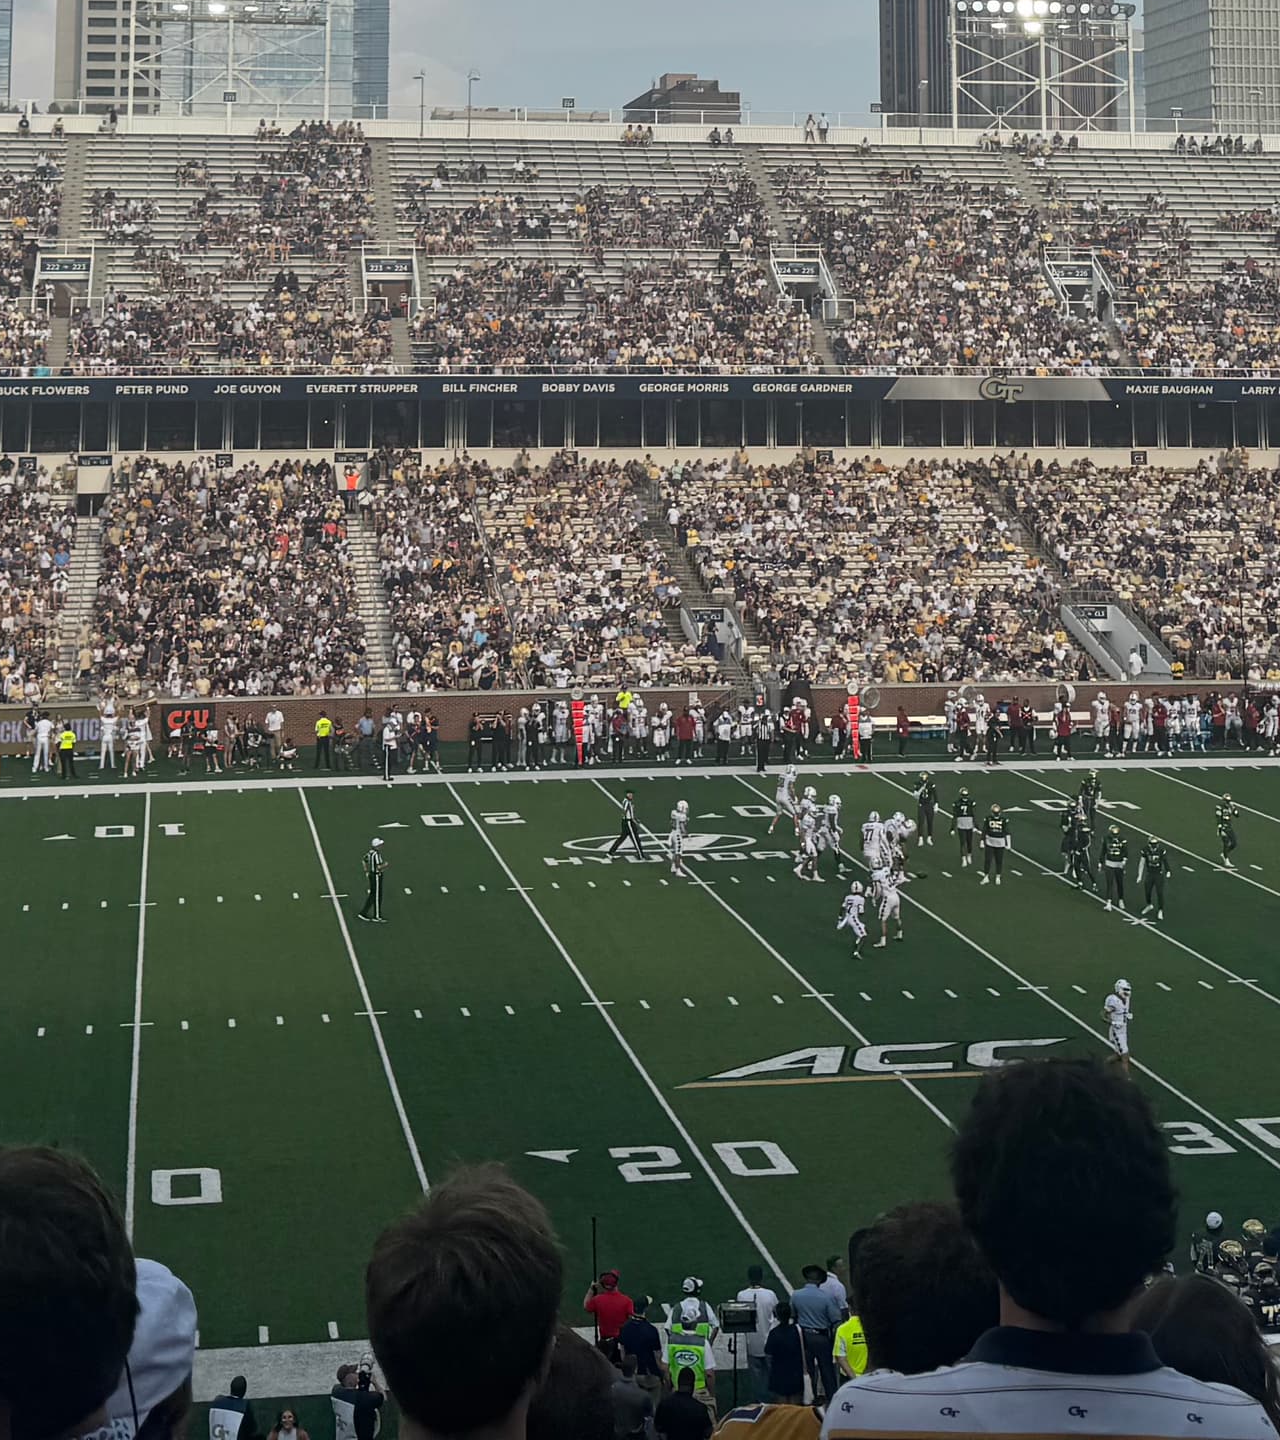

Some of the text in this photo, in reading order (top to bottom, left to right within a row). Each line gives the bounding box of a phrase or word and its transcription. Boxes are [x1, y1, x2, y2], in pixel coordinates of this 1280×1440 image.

[32, 386, 90, 395] FLOWERS
[116, 385, 189, 395] PETER PUND
[214, 385, 281, 394] JOE GUYON
[306, 384, 418, 393] EVERETT STRUPPER
[442, 384, 518, 393] BILL FINCHER
[542, 384, 616, 393] BOBBY DAVIS
[639, 384, 729, 393] GEORGE MORRIS
[752, 384, 853, 393] GEORGE GARDNER
[979, 374, 1023, 403] GT
[1126, 385, 1213, 395] MAXIE BAUGHAN
[1241, 386, 1276, 395] LARRY
[708, 1038, 1068, 1079] ACC
[608, 1141, 799, 1182] 20
[152, 1168, 222, 1206] 0
[675, 1352, 697, 1362] ACC
[939, 1407, 960, 1418] GT
[1068, 1406, 1088, 1418] GT
